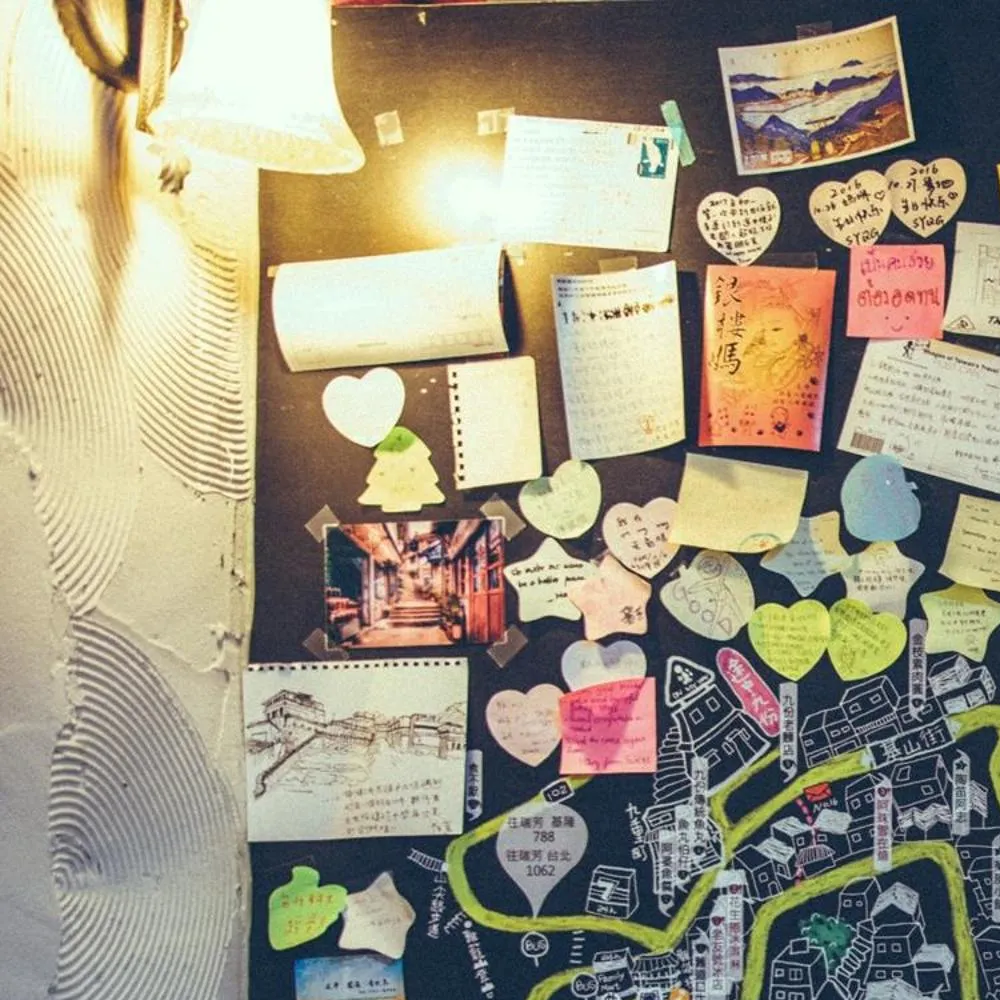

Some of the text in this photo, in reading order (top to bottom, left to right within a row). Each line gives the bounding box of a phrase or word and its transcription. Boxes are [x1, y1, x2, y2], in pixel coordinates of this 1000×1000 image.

[880, 725, 946, 761] 基山街
[533, 831, 556, 843] 788
[526, 865, 556, 877] 1062
